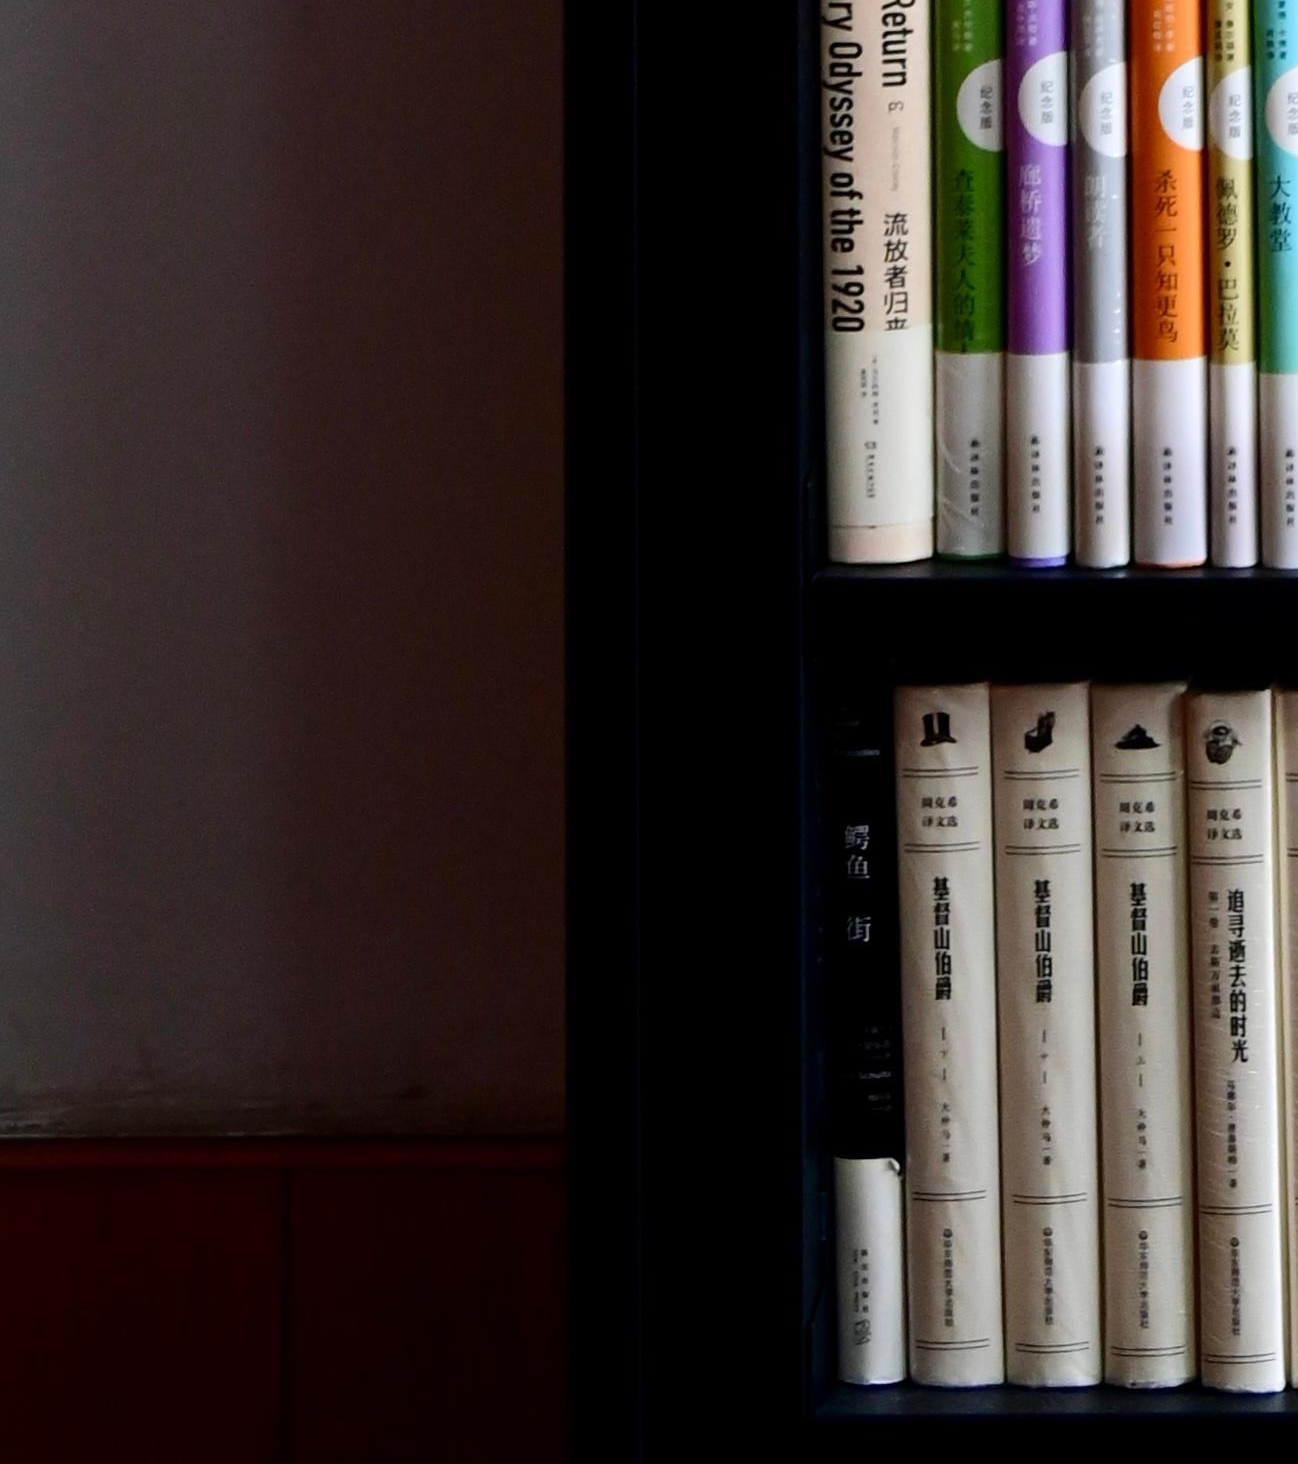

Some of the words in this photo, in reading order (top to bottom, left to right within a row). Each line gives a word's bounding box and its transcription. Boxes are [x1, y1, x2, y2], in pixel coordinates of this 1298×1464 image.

[822, 42, 863, 162] Odyssey
[830, 173, 863, 201] of
[831, 208, 863, 253] the
[1270, 173, 1292, 254] 大教堂
[832, 265, 864, 333] 1920
[1156, 168, 1179, 344] 杀死一只知更鸟
[933, 876, 953, 1001] 基督山伯爵
[1034, 879, 1053, 1004] 基督山伯爵
[1130, 881, 1149, 1007] 基督山伯爵
[1228, 888, 1247, 1064] 追寻逝去的时光
